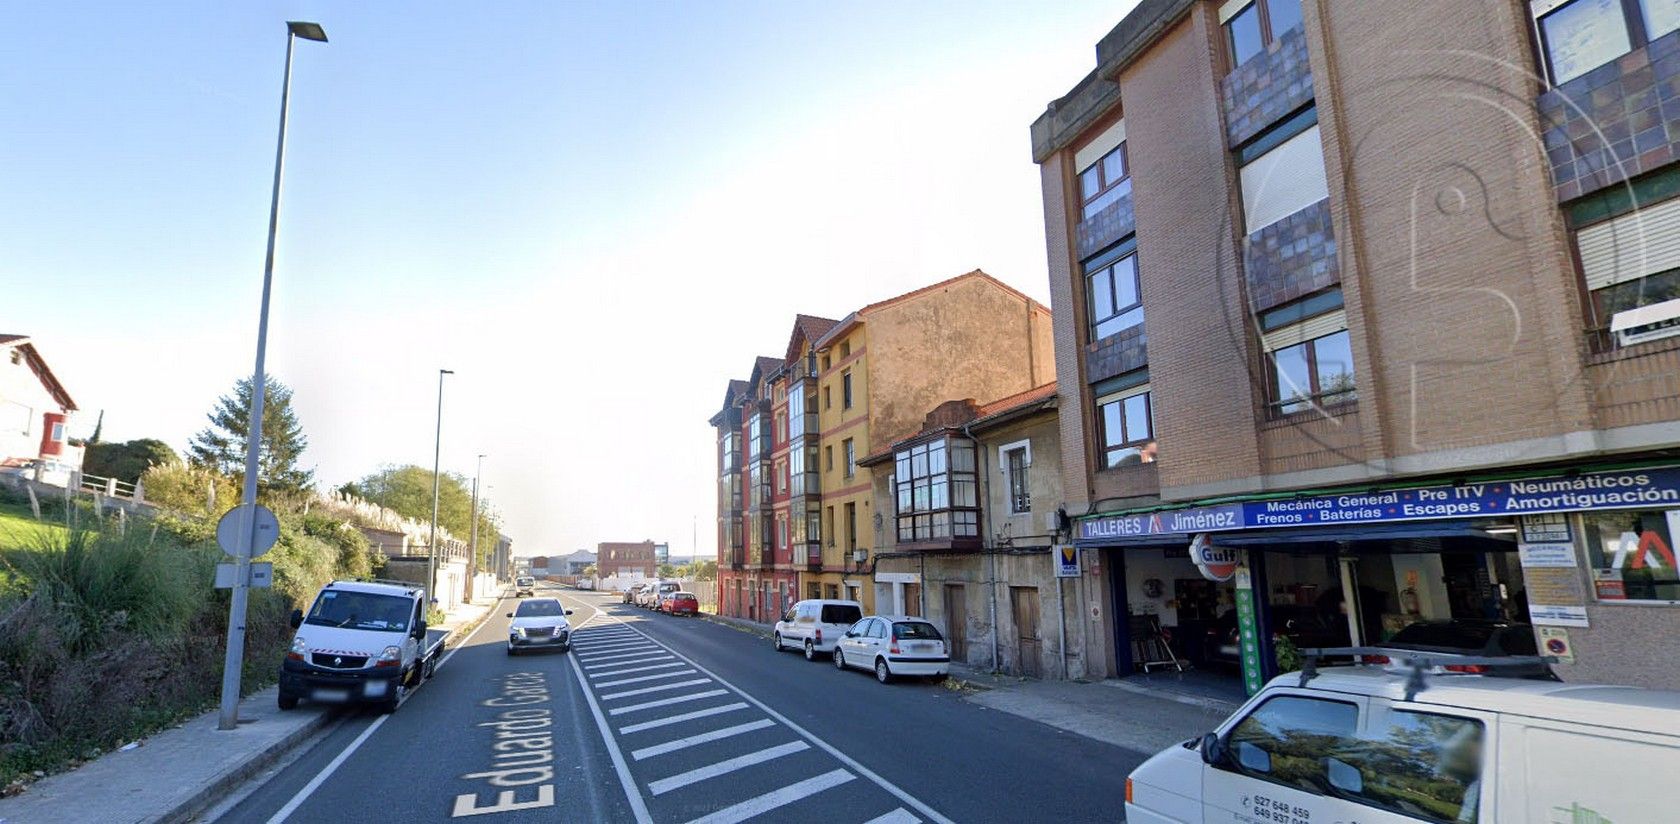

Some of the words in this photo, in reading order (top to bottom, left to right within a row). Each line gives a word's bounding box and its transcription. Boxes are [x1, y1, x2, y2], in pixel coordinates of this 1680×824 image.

[1257, 513, 1303, 524] Frenos
[1320, 508, 1381, 521] Baterías
[1403, 502, 1481, 516] Escapes
[1506, 487, 1679, 510] Amortiguación
[1267, 499, 1332, 512] Mecánica
[1338, 492, 1398, 508] General
[1419, 489, 1448, 501] Pre
[1455, 485, 1484, 499] ITV
[1510, 475, 1650, 495] Neumáticos
[1086, 518, 1142, 536] TALLERES
[1171, 511, 1236, 531] Jiménez
[1201, 547, 1236, 562] Gulf
[1254, 795, 1271, 807] 627
[1272, 801, 1290, 813] 648
[1292, 807, 1310, 819] 459
[1254, 806, 1271, 819] 649
[1273, 812, 1290, 824] 937
